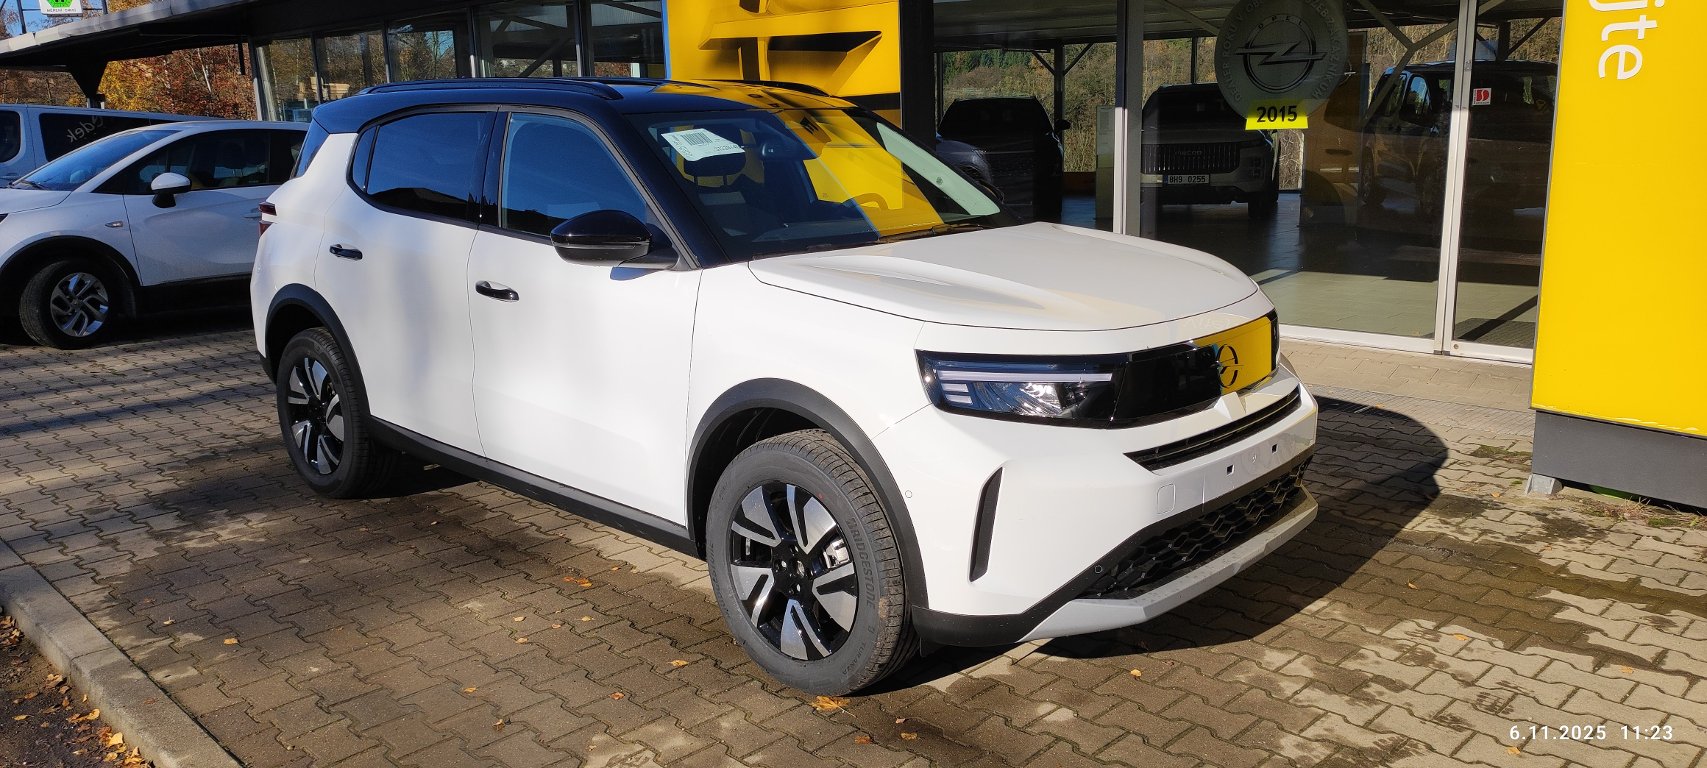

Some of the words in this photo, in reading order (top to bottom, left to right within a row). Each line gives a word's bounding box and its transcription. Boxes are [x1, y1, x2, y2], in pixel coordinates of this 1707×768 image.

[1258, 15, 1302, 29] OPEL
[1256, 105, 1298, 123] 2015
[1188, 175, 1206, 183] 0255
[845, 517, 876, 610] BRIDGESTONE
